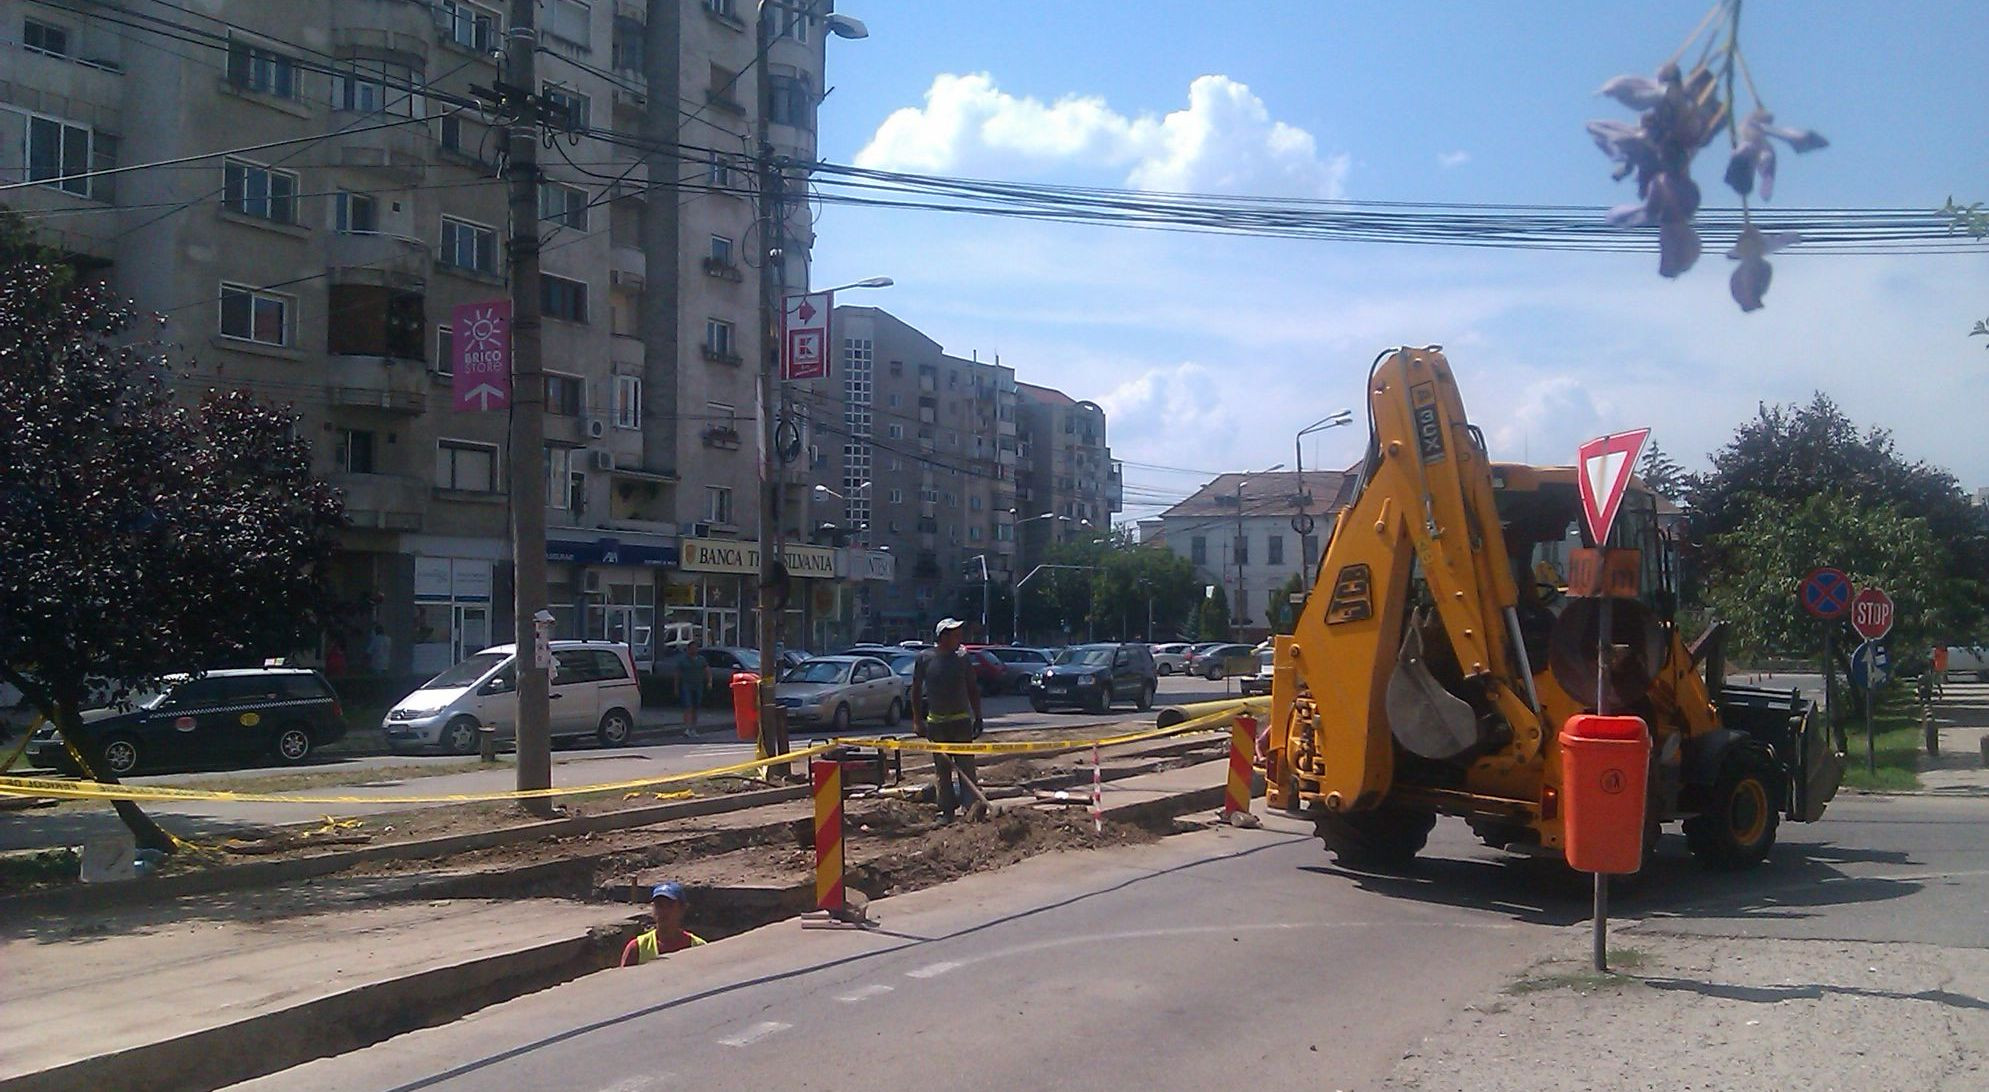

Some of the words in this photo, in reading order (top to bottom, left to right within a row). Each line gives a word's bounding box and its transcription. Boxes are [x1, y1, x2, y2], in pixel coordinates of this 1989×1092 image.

[464, 350, 502, 363] BRICO
[464, 362, 503, 374] STORE
[700, 547, 742, 566] BANCA
[748, 550, 832, 571] TSILVANIA
[1858, 602, 1889, 625] STOP
